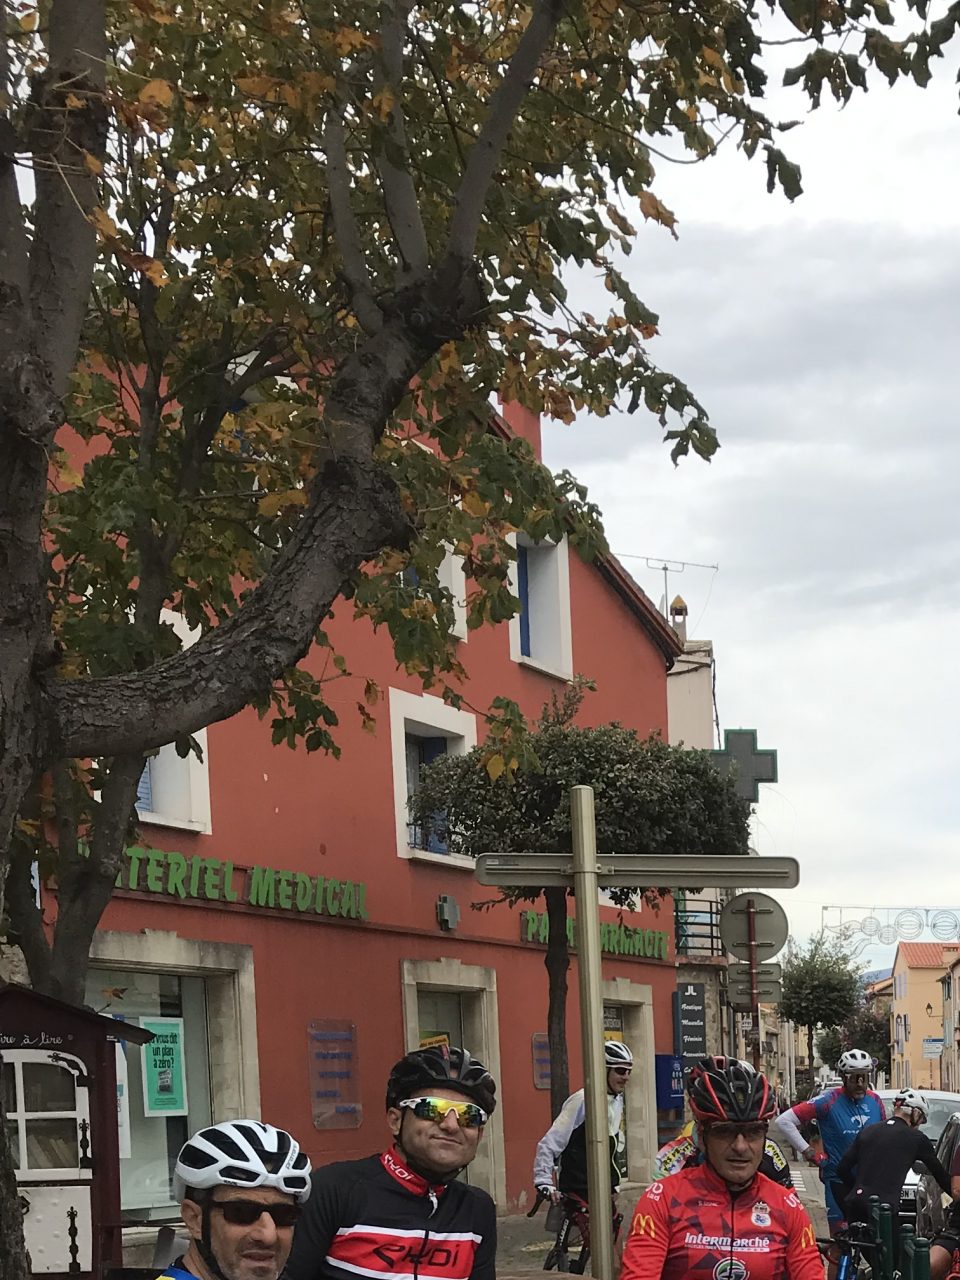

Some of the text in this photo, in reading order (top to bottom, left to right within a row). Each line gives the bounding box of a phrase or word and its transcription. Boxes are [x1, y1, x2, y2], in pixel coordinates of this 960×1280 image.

[112, 846, 370, 920] TERIEL MEDICAL
[681, 1003, 703, 1011] Boutique
[39, 1032, 63, 1046] lire
[157, 1034, 169, 1044] vous
[169, 1033, 178, 1044] dit
[153, 1045, 174, 1058] un plan
[685, 1232, 770, 1248] Intermarché
